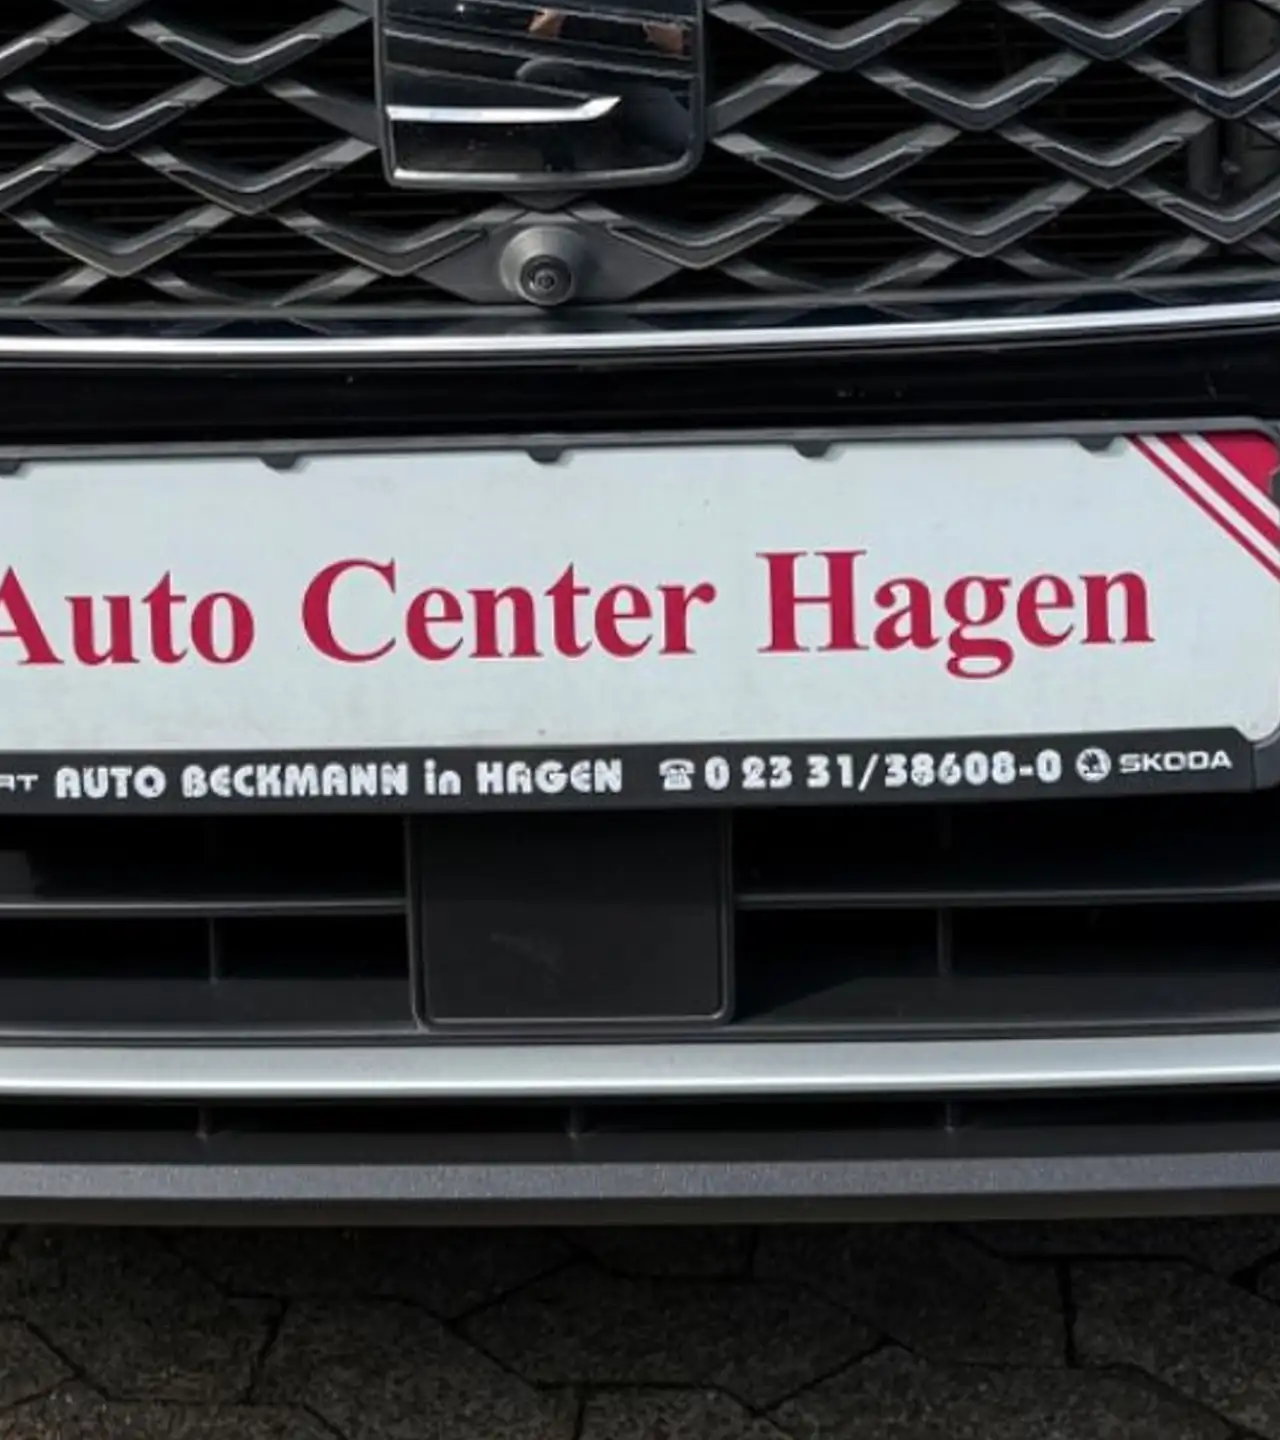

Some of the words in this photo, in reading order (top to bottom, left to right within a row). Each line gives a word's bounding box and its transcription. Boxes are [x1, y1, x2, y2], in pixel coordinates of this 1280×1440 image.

[299, 558, 719, 666] Center
[758, 549, 1154, 680] Hagen
[54, 765, 166, 799] AUTO
[180, 762, 409, 798] BECKMANN
[424, 759, 461, 796] in
[476, 758, 623, 795] HAGEN
[704, 756, 730, 791] 0
[741, 755, 793, 790] 23
[806, 748, 1062, 791] 31/38608-0
